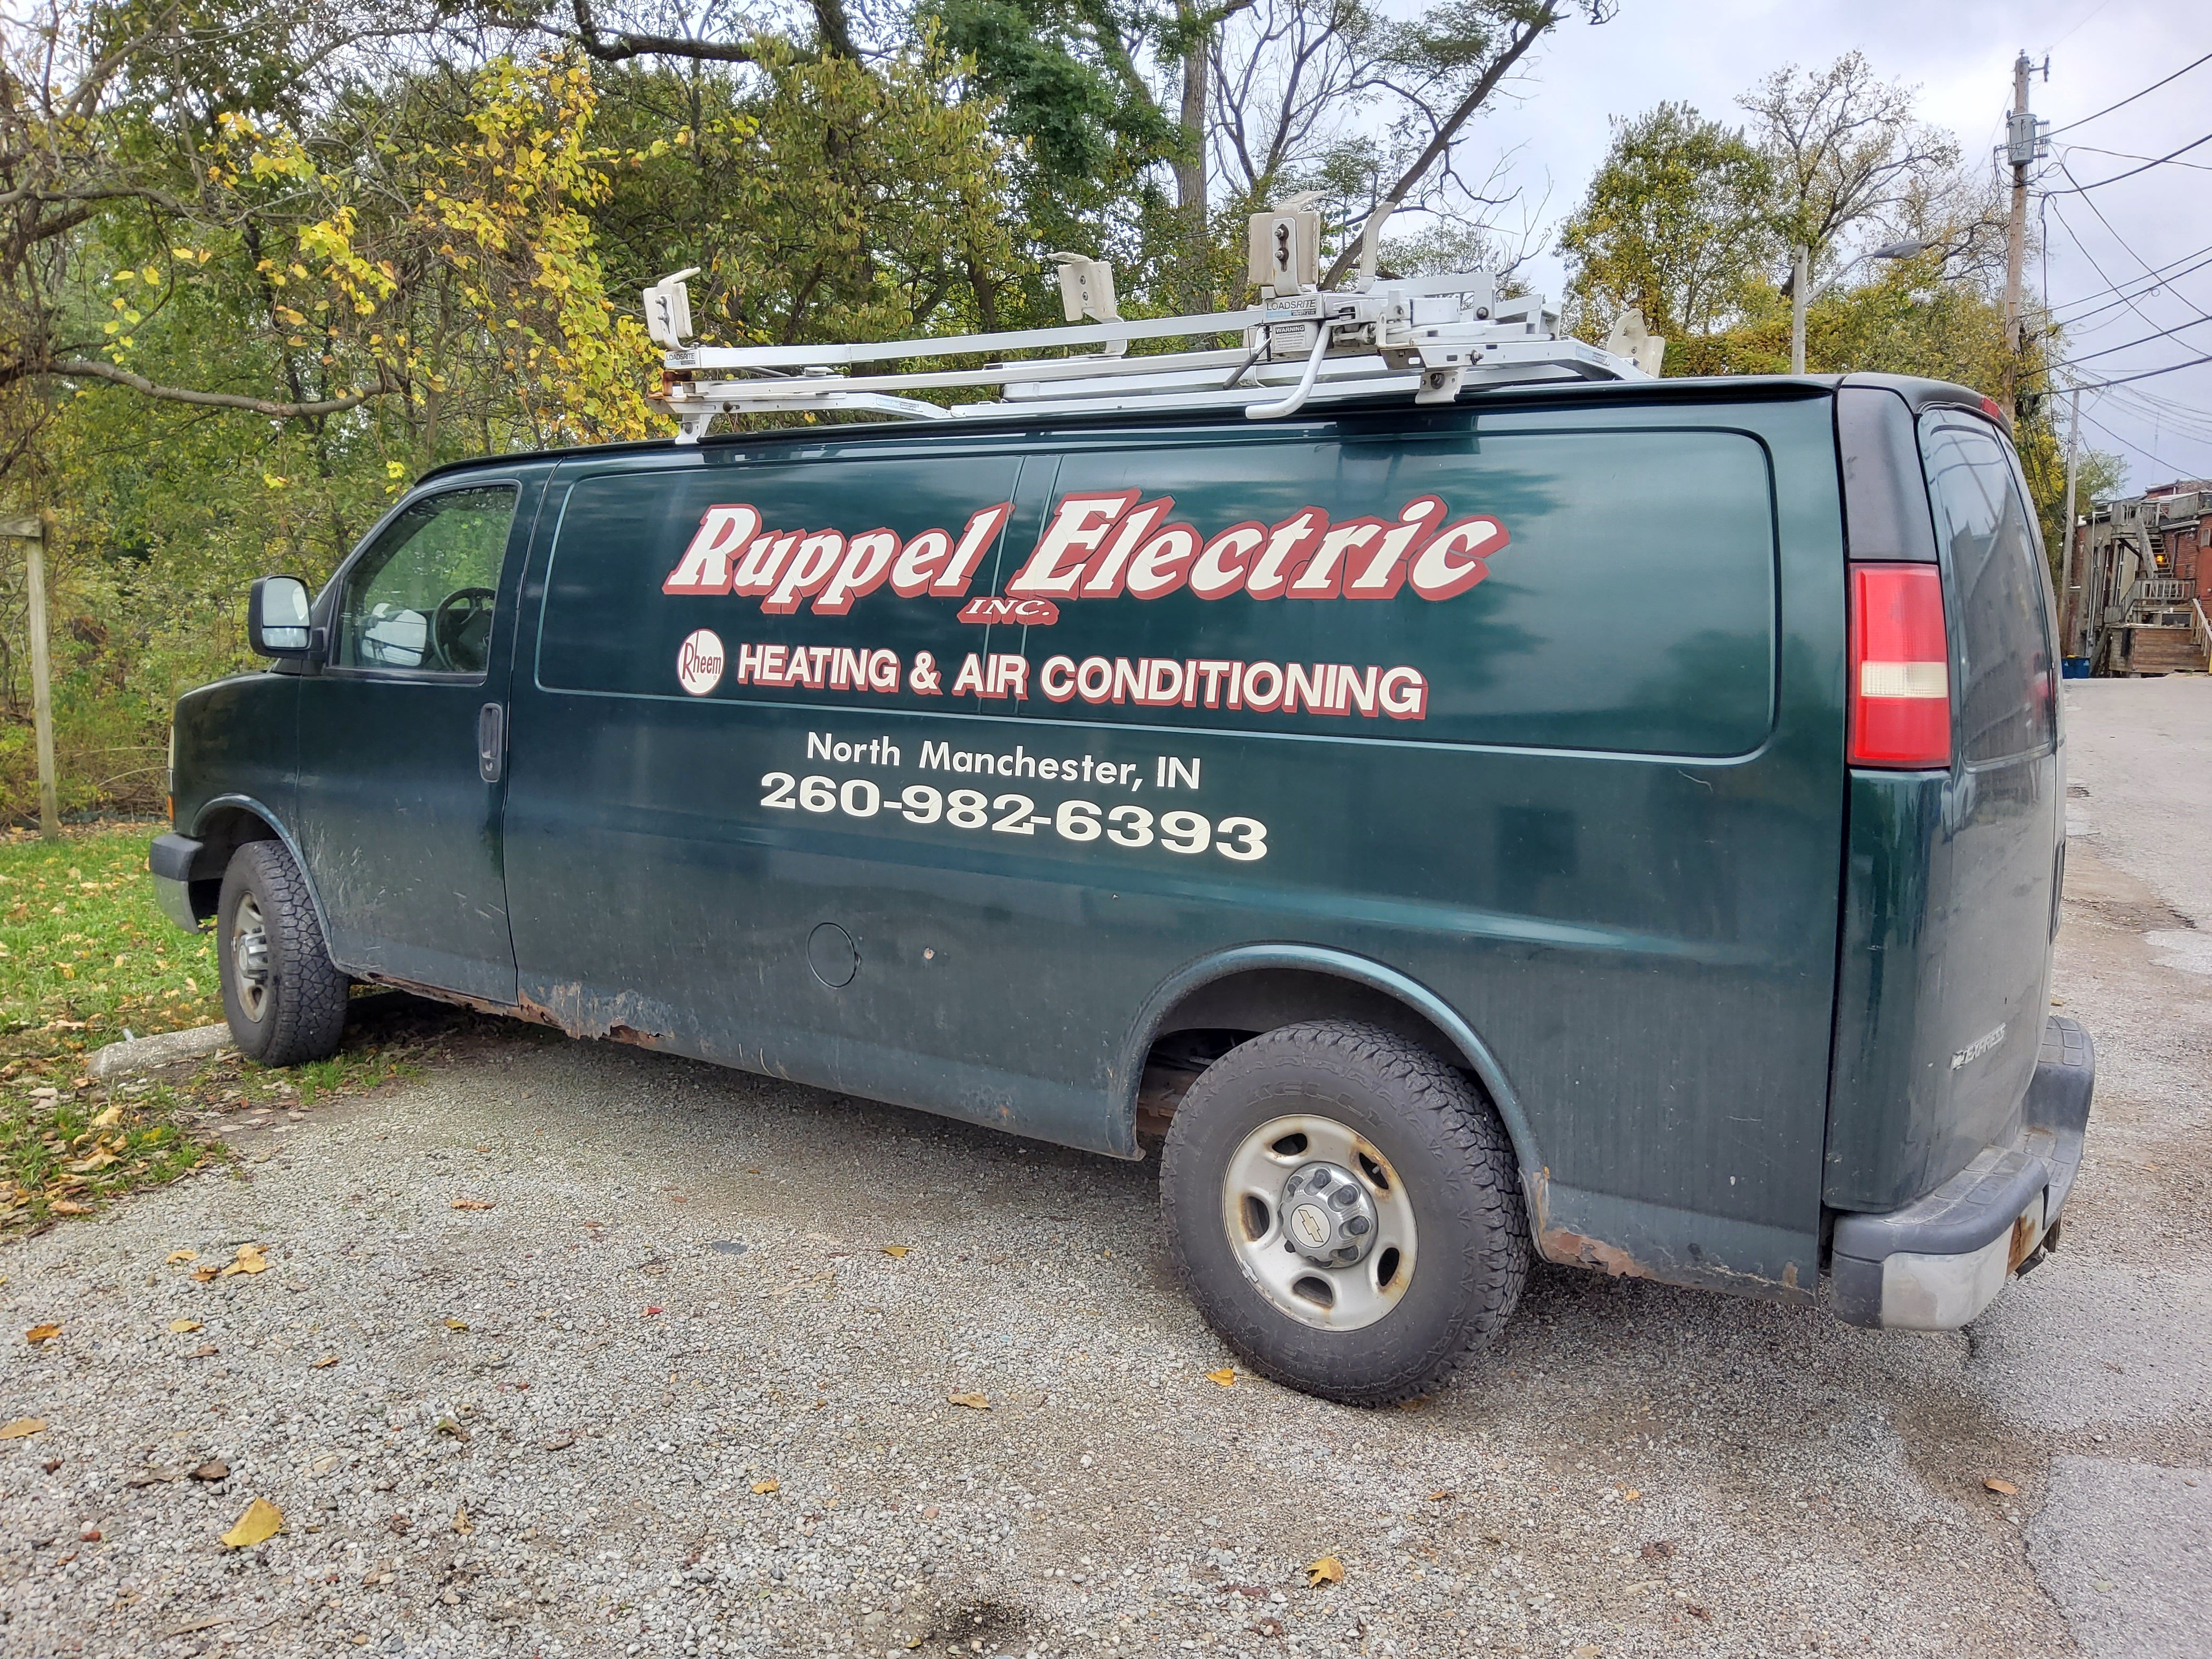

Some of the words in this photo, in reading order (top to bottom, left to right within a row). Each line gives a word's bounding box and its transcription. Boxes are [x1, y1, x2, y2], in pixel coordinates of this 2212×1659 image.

[1267, 299, 1316, 310] LOADSRITE
[666, 353, 695, 361] LOADSRITE
[663, 503, 1014, 615] Ruppel
[1006, 488, 1508, 600] Electric
[963, 597, 1052, 619] INC.
[682, 631, 722, 683] Rheem
[737, 644, 899, 691] HEATING
[909, 651, 941, 693] &
[952, 653, 1028, 699] AIR
[1040, 655, 1429, 719] CONDITIONING
[807, 731, 900, 766] North
[918, 740, 1143, 792] Manchester,
[1156, 756, 1200, 789] IN
[760, 772, 1268, 861] 260-982-6393
